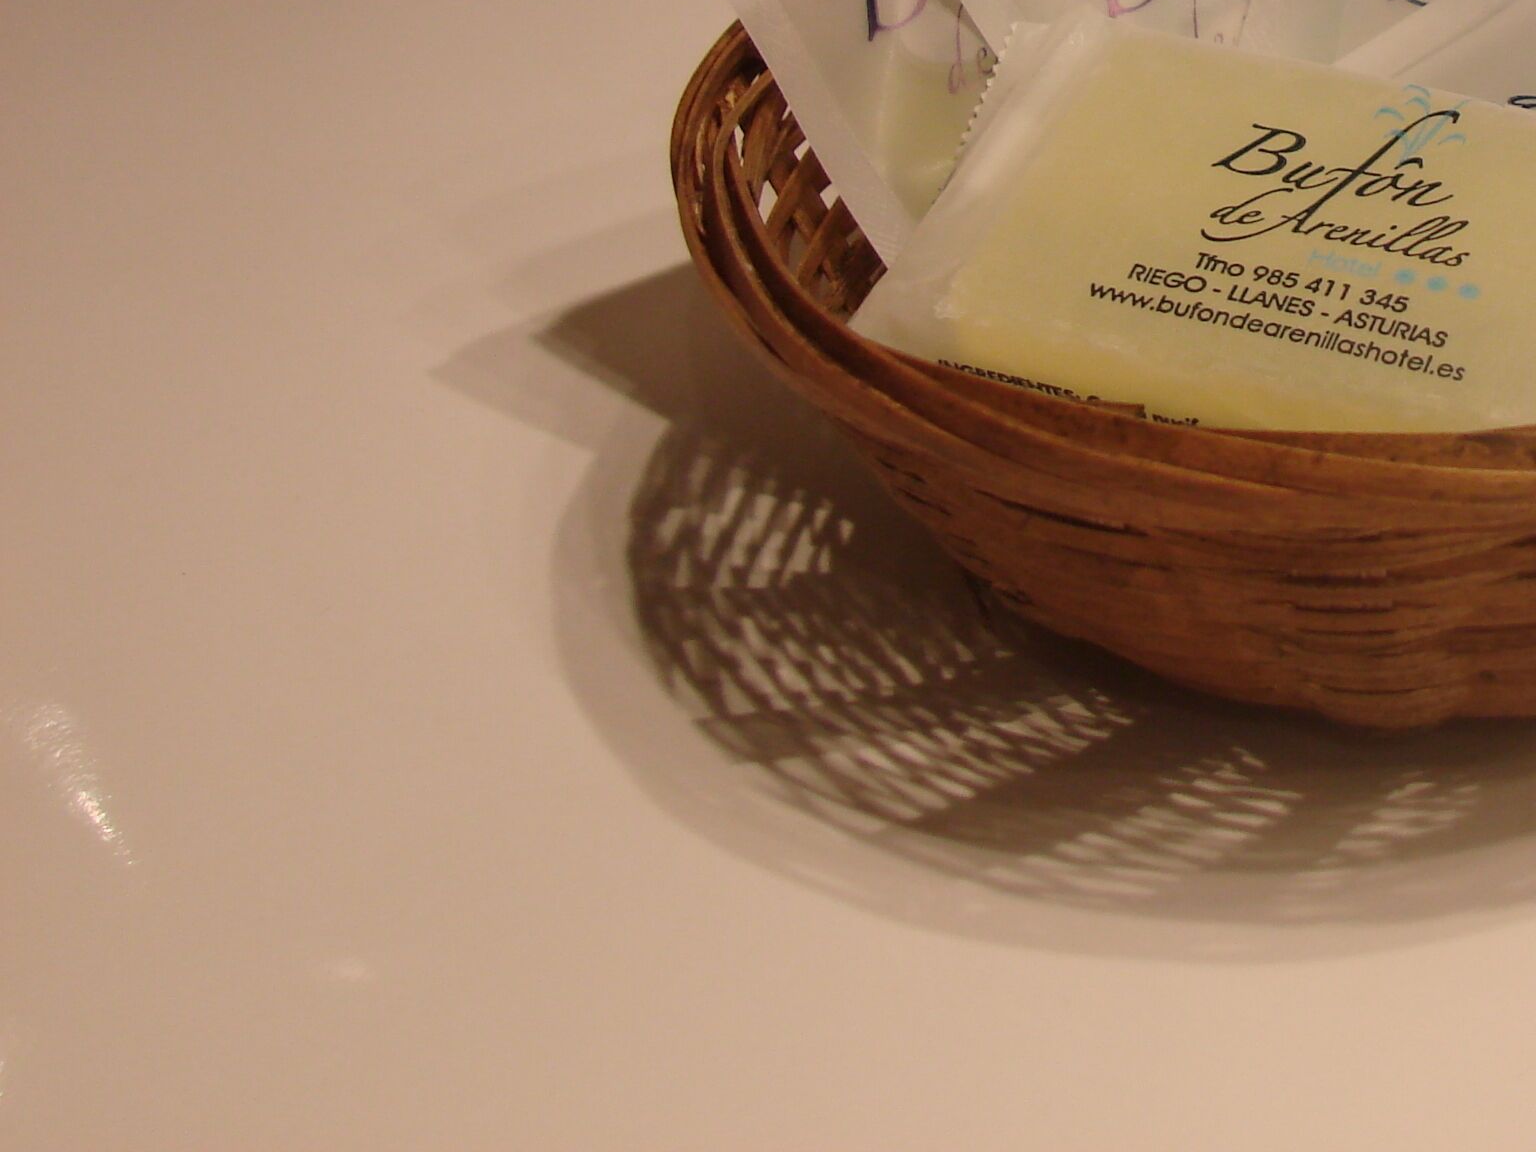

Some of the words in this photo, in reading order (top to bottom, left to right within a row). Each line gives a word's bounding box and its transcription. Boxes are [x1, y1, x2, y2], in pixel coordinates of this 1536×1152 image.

[1209, 187, 1294, 226] de
[1281, 210, 1472, 268] Arenillas
[1127, 262, 1208, 294] RIEGO
[1226, 283, 1315, 318] LLANES
[1333, 308, 1449, 348] ASTURIAS
[1253, 264, 1300, 290] 985
[1304, 277, 1351, 302] 411
[1358, 289, 1411, 314] 345
[1089, 282, 1466, 382] www.bufondearenillashotel.es
